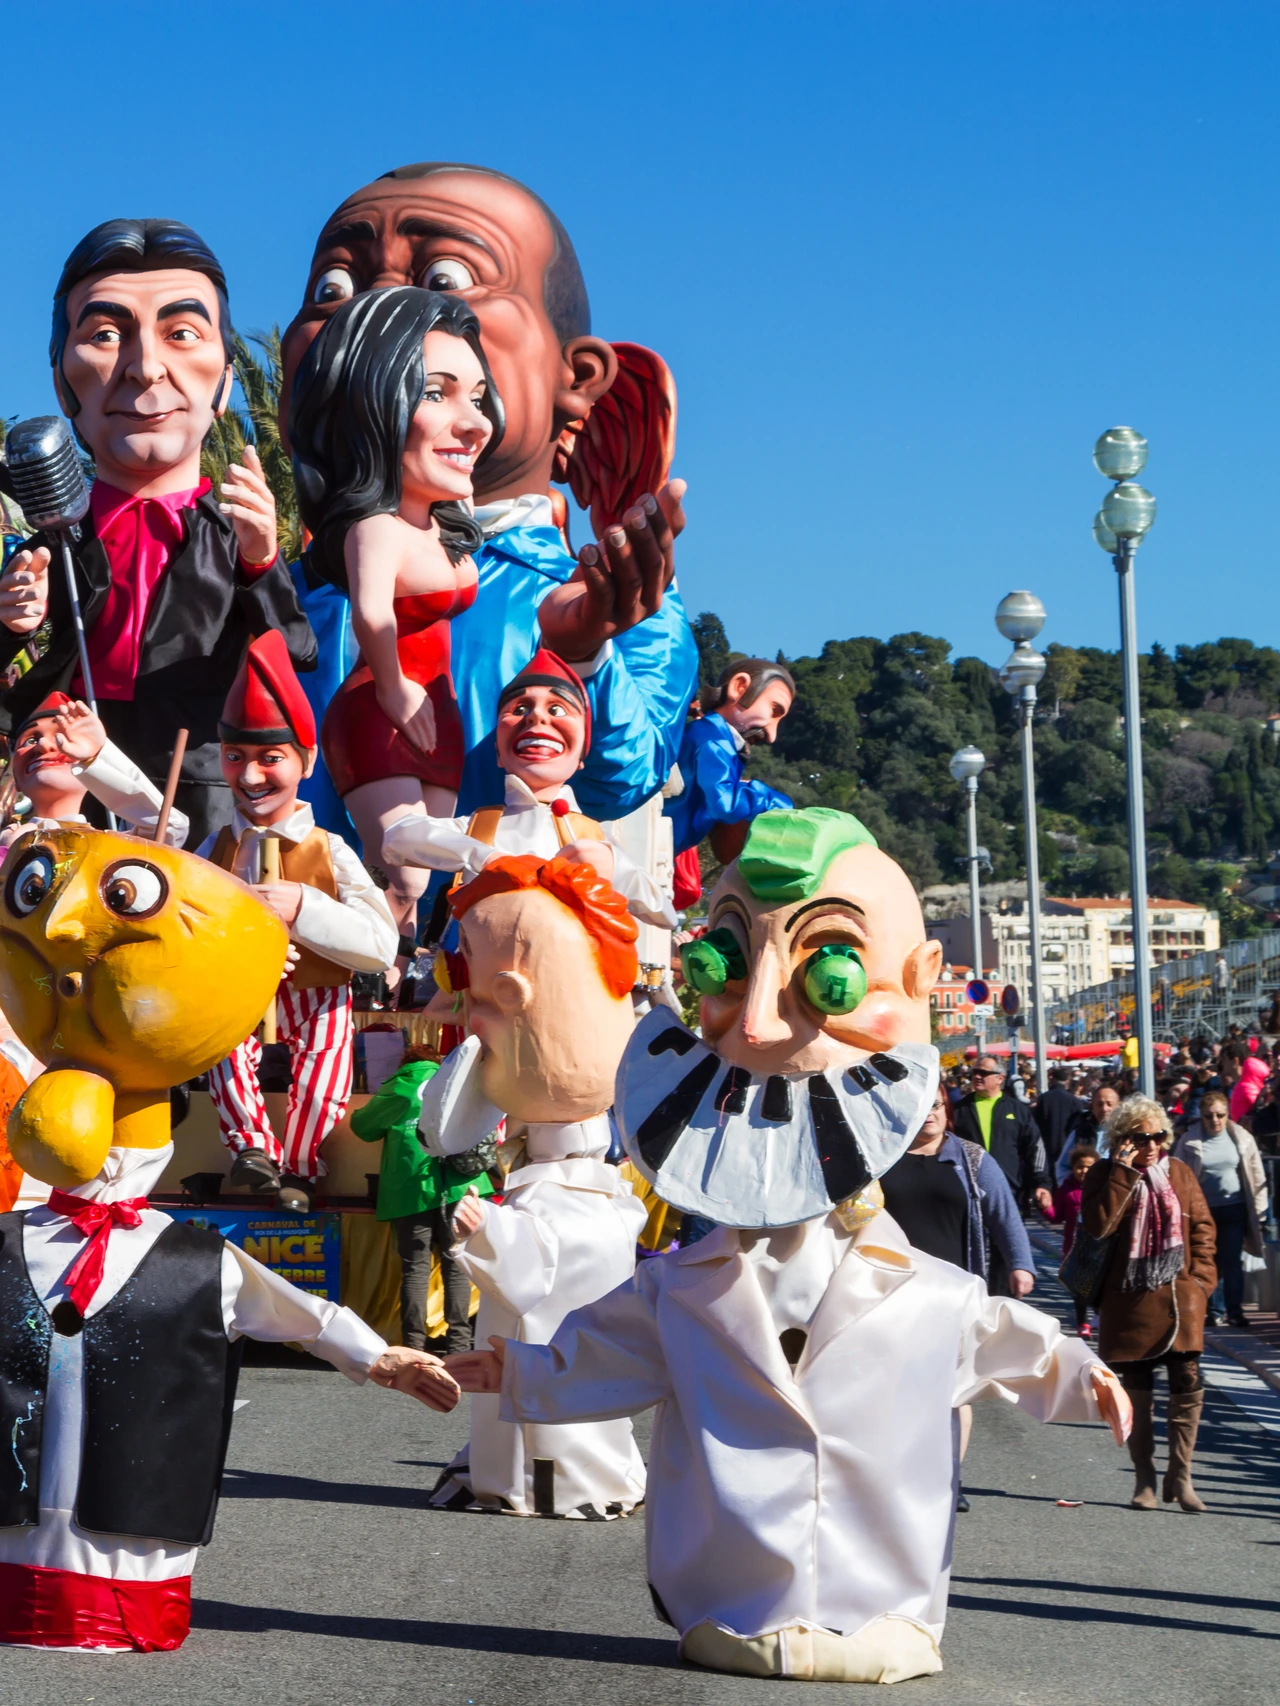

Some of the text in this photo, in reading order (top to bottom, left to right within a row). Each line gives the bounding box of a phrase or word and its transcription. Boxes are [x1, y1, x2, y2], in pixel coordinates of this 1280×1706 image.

[247, 1219, 316, 1230] CARNAVAL DE
[243, 1235, 324, 1264] NICE
